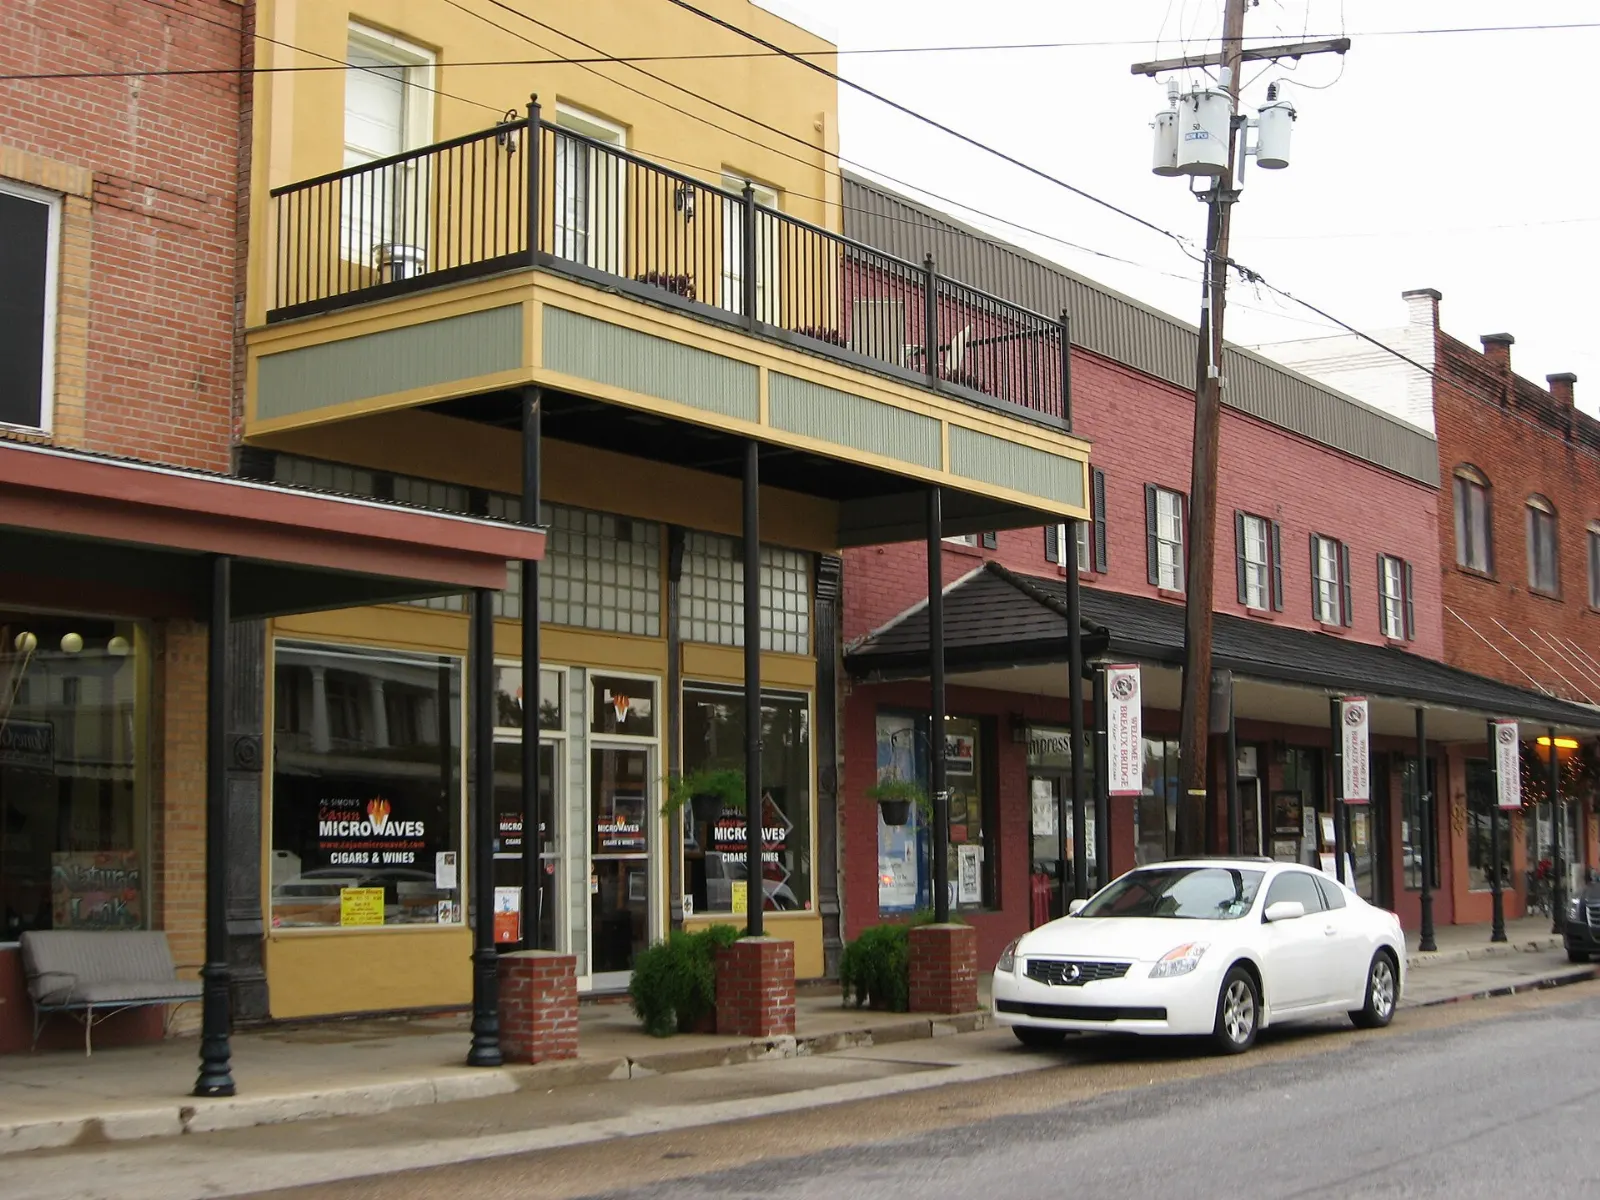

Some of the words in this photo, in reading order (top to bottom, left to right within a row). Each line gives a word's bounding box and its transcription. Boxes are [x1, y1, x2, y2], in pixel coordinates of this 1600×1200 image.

[1120, 705, 1128, 746] BREAUX
[1120, 749, 1129, 788] BRIDGE
[1131, 763, 1138, 775] TO
[319, 814, 425, 837] MICROWAVES
[597, 820, 639, 832] MICROWAVES
[330, 851, 370, 864] CIGARS
[371, 851, 380, 864] &
[382, 851, 415, 864] WINES
[761, 851, 779, 862] INES
